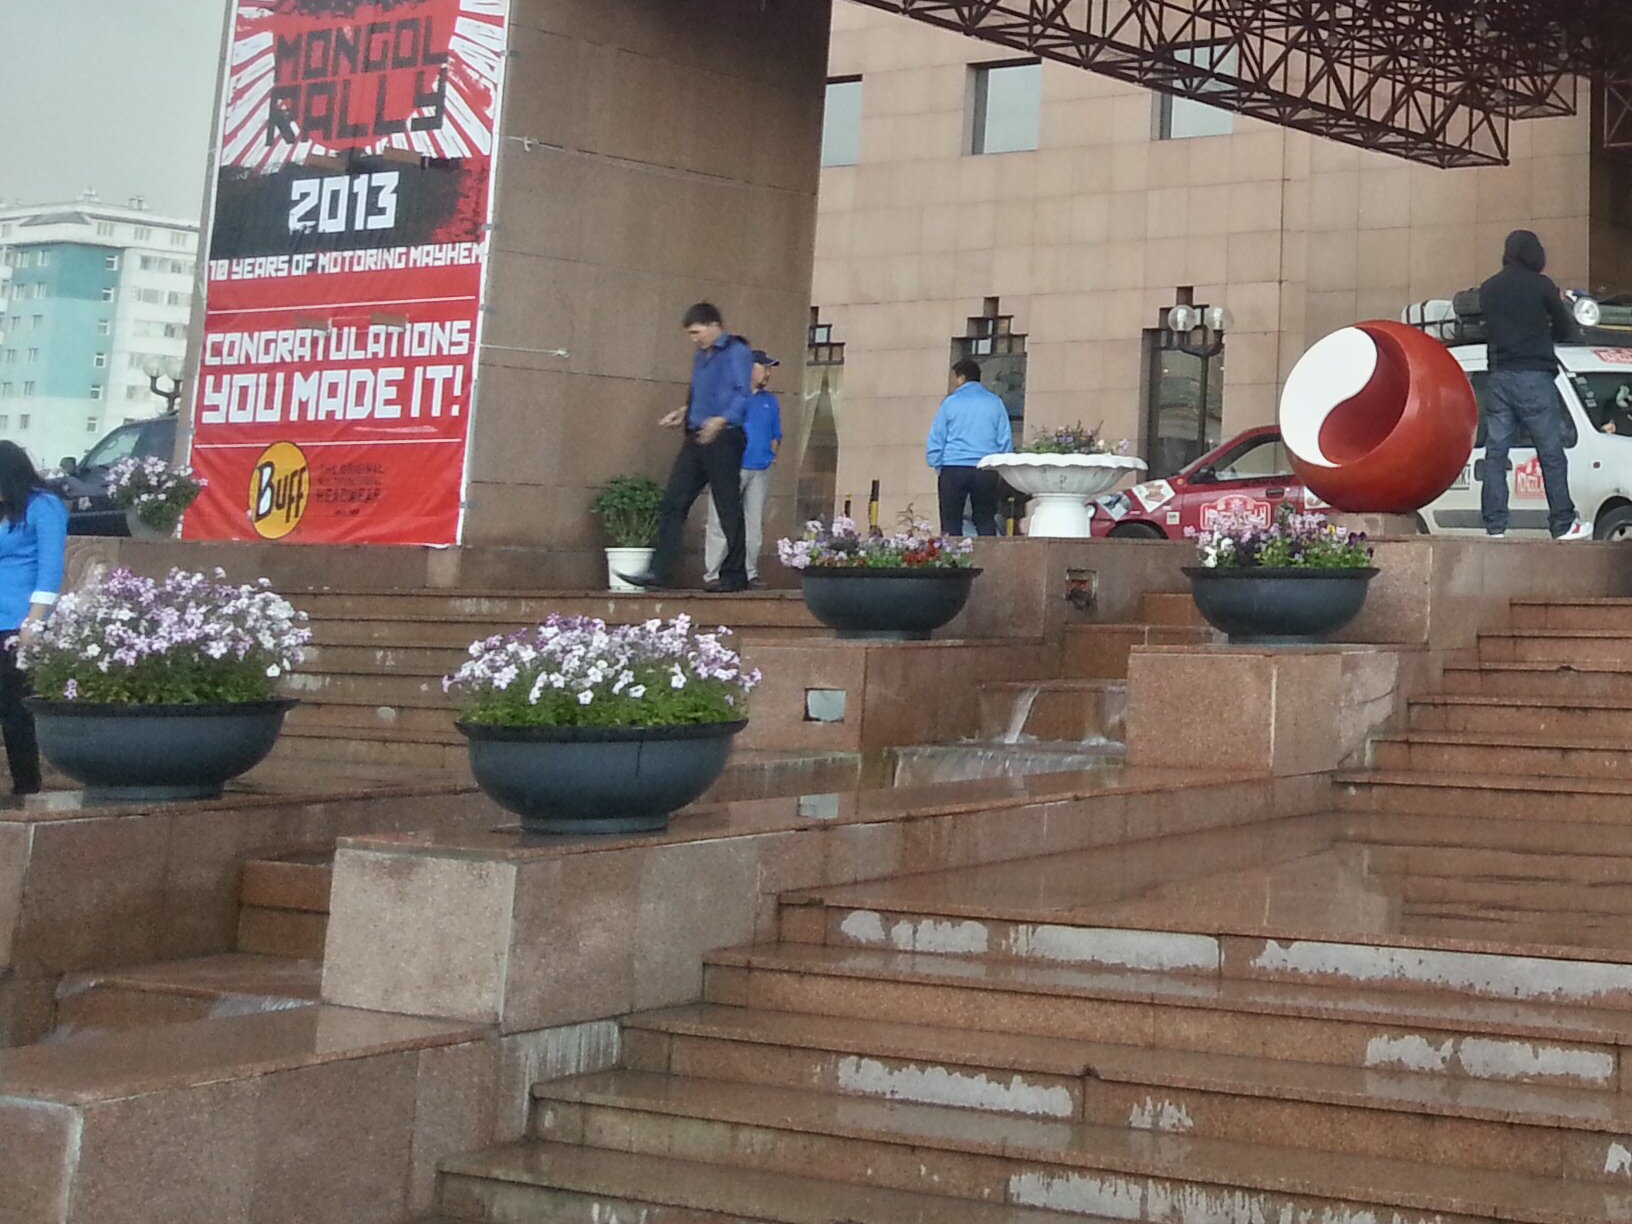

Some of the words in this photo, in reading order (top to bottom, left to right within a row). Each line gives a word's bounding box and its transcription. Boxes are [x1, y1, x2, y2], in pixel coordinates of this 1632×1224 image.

[275, 16, 448, 83] MONGOL
[266, 66, 448, 146] RALLY
[289, 171, 399, 234] 2013
[209, 259, 227, 281] 10
[231, 254, 290, 280] YEARS
[291, 253, 317, 276] OF
[316, 246, 407, 274] MOTORING
[408, 241, 486, 267] MAYHEM
[204, 320, 472, 366] CONGRATULATIONS
[201, 372, 284, 424] YOU
[289, 367, 404, 421] MADE
[410, 364, 464, 418] IT!
